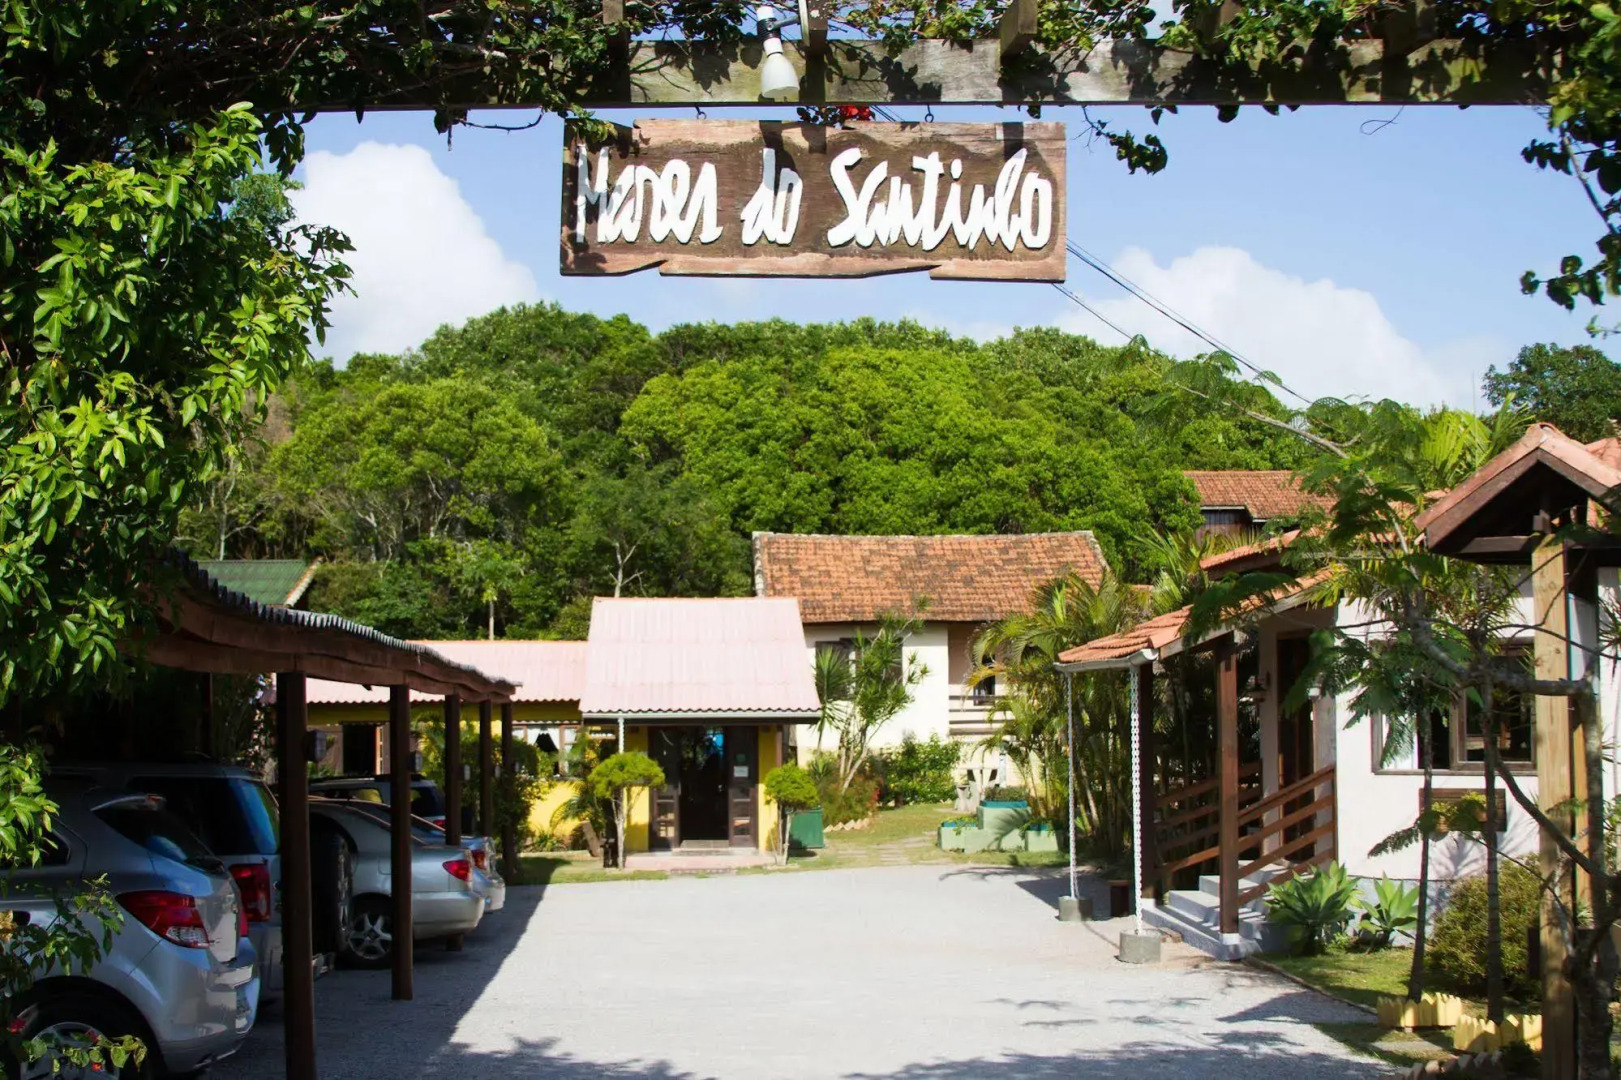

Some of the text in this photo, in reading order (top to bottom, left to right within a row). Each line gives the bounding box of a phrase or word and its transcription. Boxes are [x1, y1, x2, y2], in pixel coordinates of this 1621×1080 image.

[576, 143, 1053, 252] Mares do Santinho
